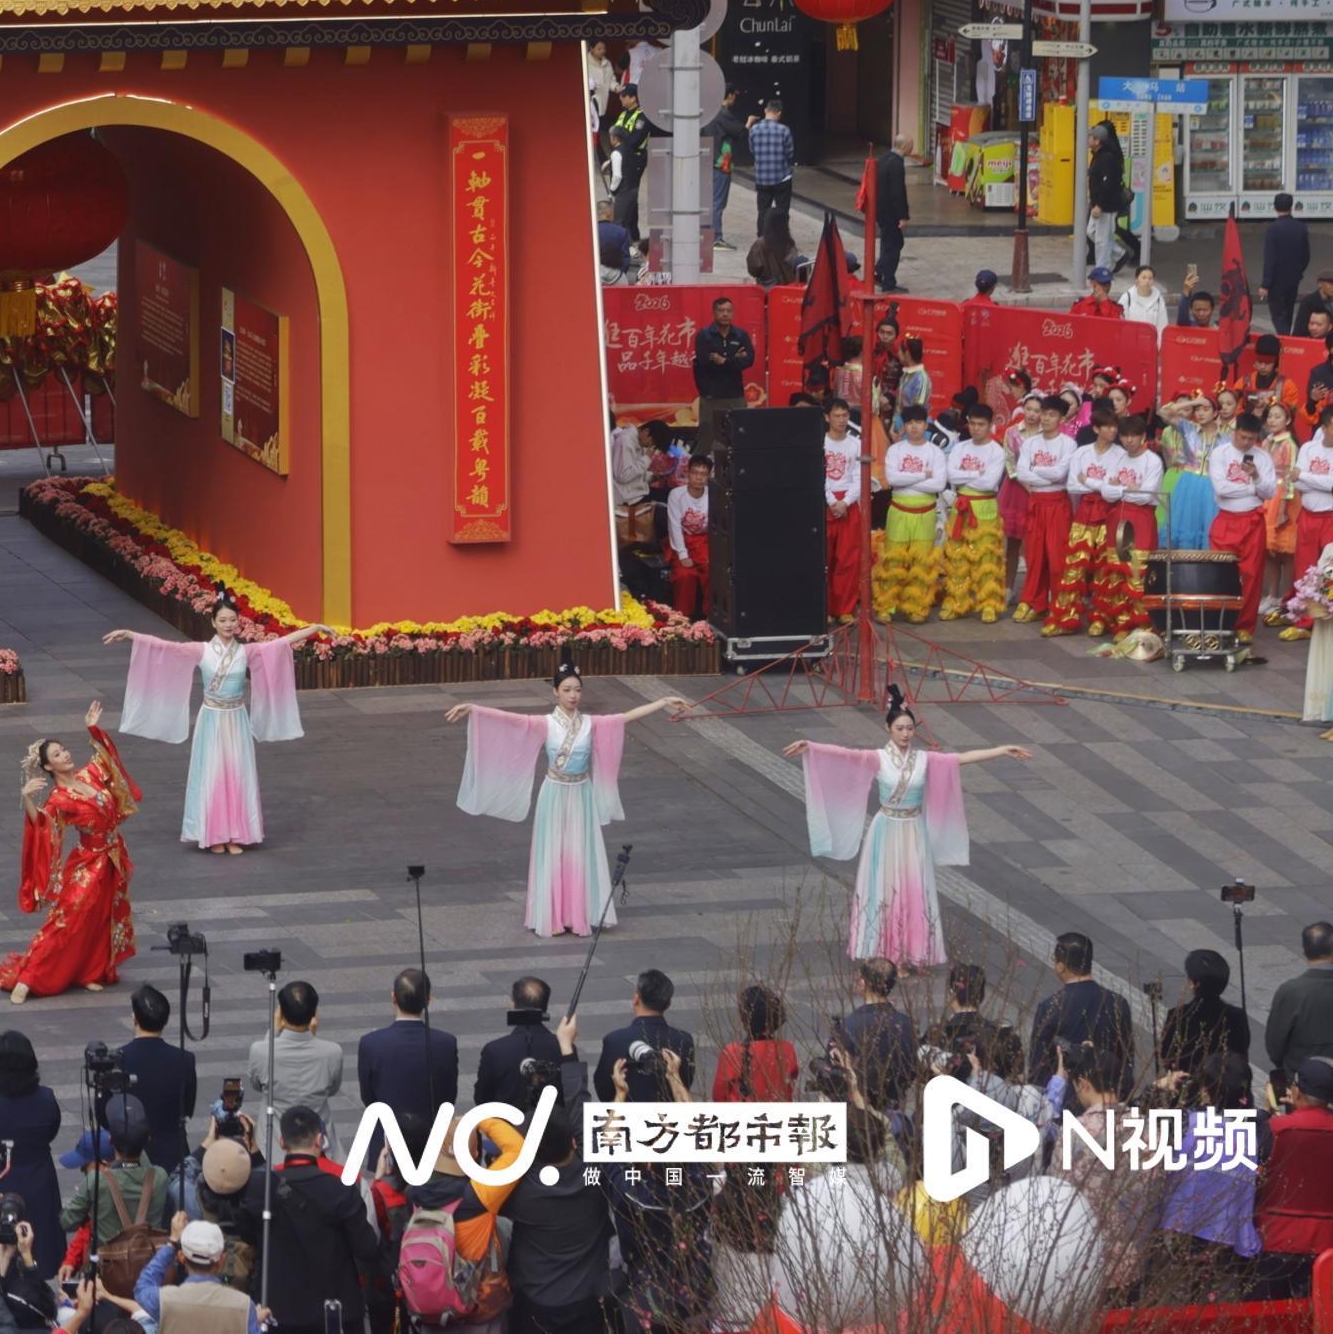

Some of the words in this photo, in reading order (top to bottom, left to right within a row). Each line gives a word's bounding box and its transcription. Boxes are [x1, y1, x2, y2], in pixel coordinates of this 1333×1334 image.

[633, 293, 672, 311] 2026
[1042, 319, 1073, 339] 2026
[617, 350, 697, 374] 品千年越
[1008, 341, 1096, 380] 逛百年花市
